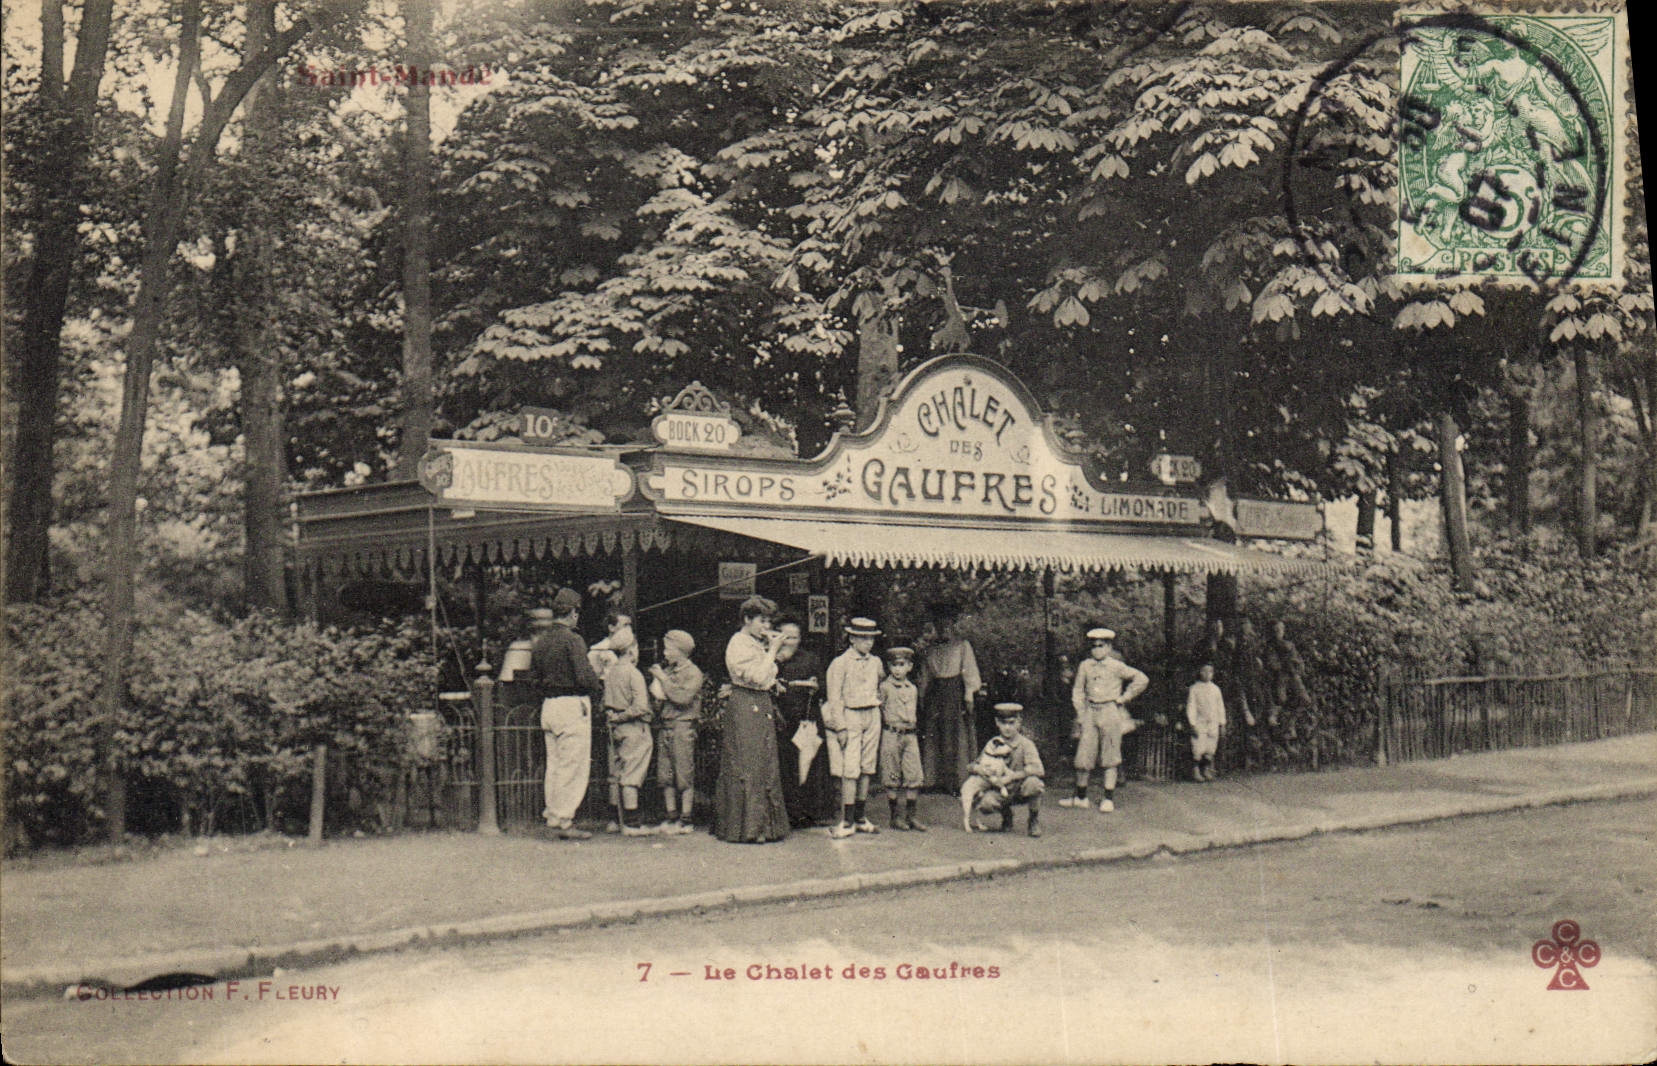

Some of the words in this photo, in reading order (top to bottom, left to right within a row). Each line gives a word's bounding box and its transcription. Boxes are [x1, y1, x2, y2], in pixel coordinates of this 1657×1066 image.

[917, 386, 1017, 445] CHALET
[668, 420, 700, 442] BOCK
[703, 422, 726, 444] 20
[950, 440, 984, 460] DES
[681, 470, 796, 501] SIROPS
[861, 458, 1057, 515] GAUFRES
[1101, 496, 1190, 521] LIMONADE
